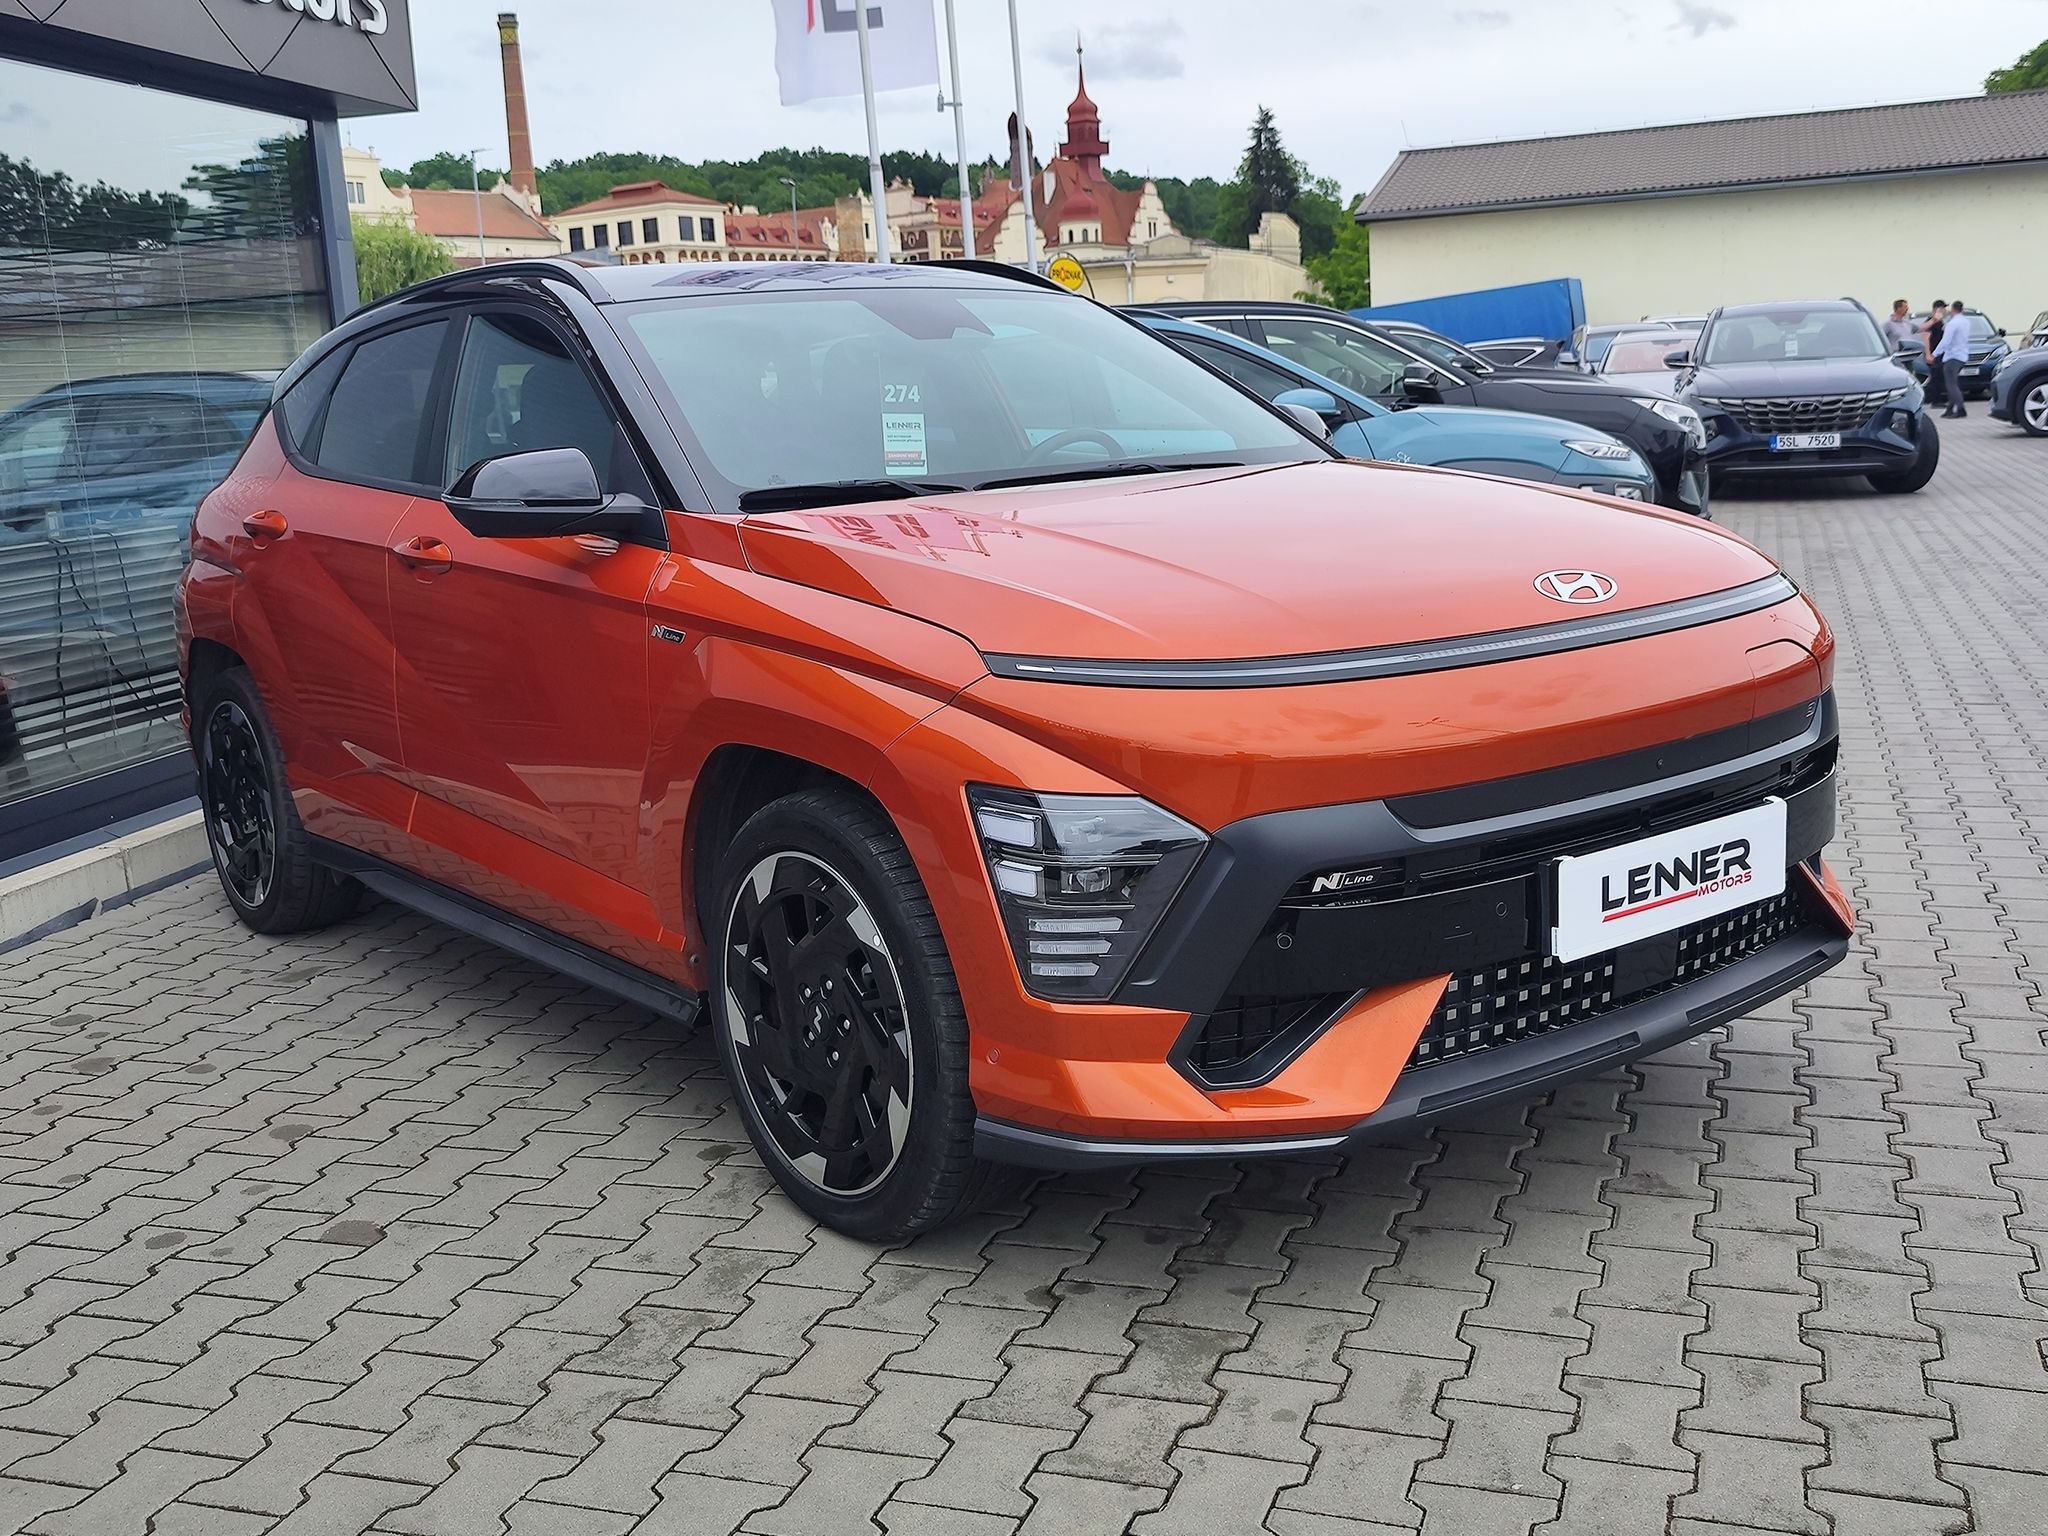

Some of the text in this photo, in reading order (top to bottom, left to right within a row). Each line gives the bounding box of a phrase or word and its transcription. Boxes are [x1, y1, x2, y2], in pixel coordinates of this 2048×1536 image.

[884, 384, 920, 403] 274
[886, 421, 922, 430] LENNER
[1779, 436, 1799, 448] 5SL
[1807, 434, 1835, 447] 7520
[1344, 875, 1375, 886] Line
[1601, 838, 1752, 912] LENNER
[1698, 870, 1753, 897] MOTORS
